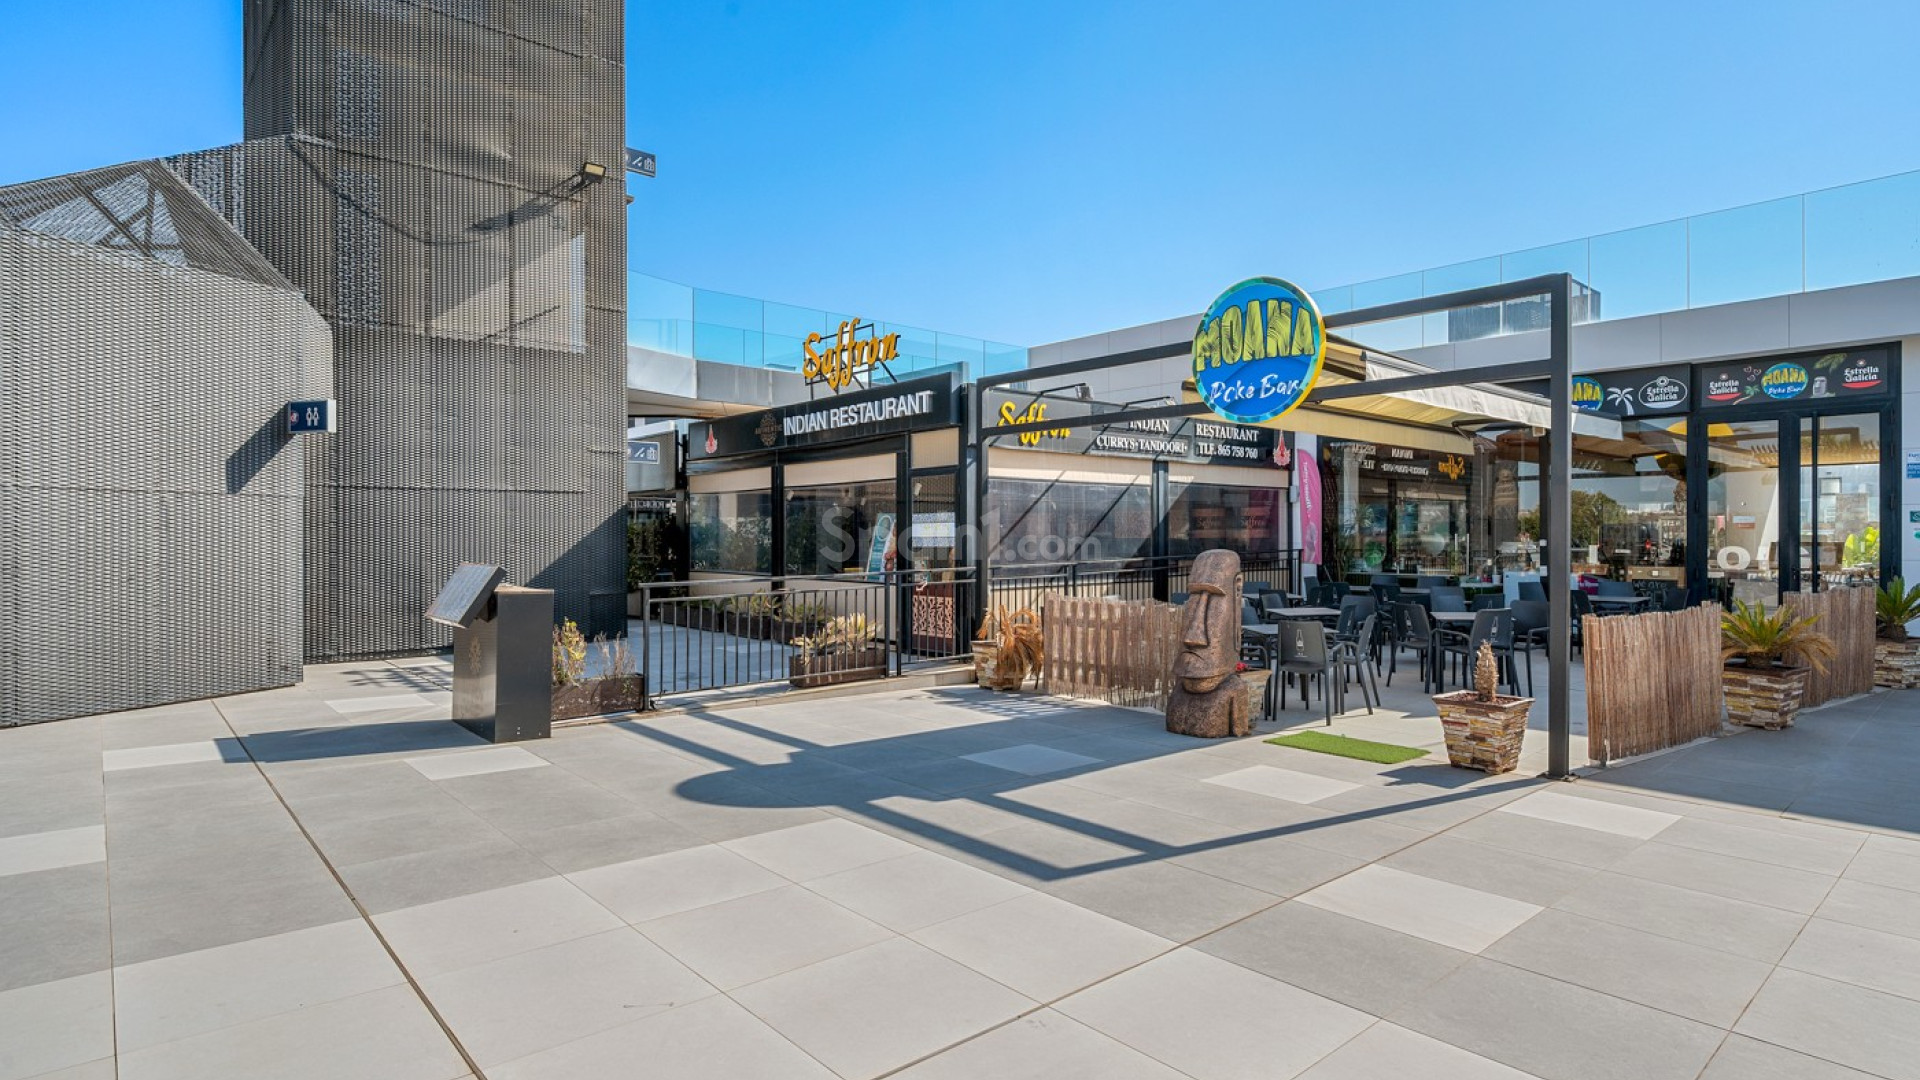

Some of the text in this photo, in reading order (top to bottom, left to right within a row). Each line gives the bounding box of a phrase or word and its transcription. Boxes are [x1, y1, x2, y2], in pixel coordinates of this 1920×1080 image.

[1196, 299, 1315, 372] MOANA
[803, 317, 897, 389] Saffron
[1763, 368, 1806, 385] MOANA
[1844, 366, 1879, 375] Estrella
[1845, 374, 1877, 383] Galicia
[1260, 373, 1301, 399] Bar
[1646, 385, 1679, 395] Estrella
[1710, 379, 1739, 388] Estrella
[1710, 386, 1738, 395] Galicia
[1572, 382, 1600, 402] ANA
[1647, 393, 1678, 402] Galicia
[783, 391, 933, 436] INDIAN RESTAURANT
[1129, 418, 1259, 442] INDIAN RESTAURANT
[1217, 444, 1230, 457] 865
[1231, 445, 1244, 458] 758
[1245, 447, 1258, 459] 760
